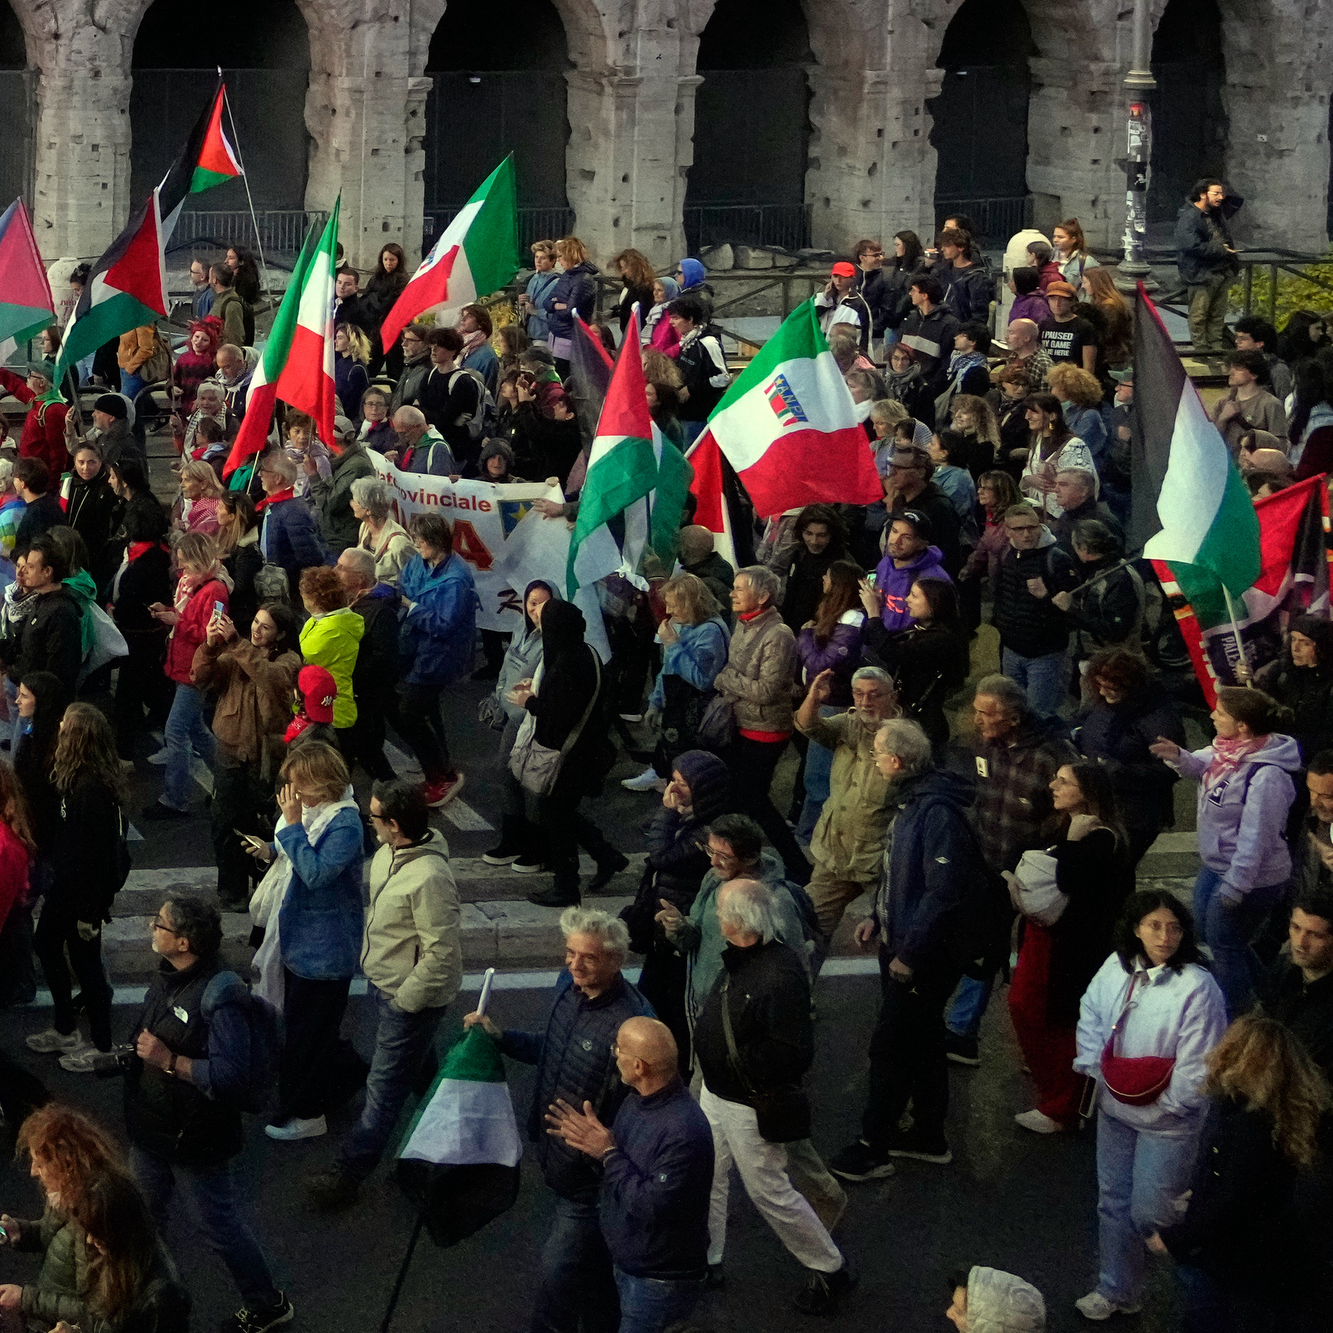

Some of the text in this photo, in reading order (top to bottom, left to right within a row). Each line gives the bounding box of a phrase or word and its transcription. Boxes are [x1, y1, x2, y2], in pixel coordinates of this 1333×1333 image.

[1045, 330, 1074, 341] PAUSED
[1050, 340, 1072, 349] GAME
[399, 488, 493, 513] ovinciale
